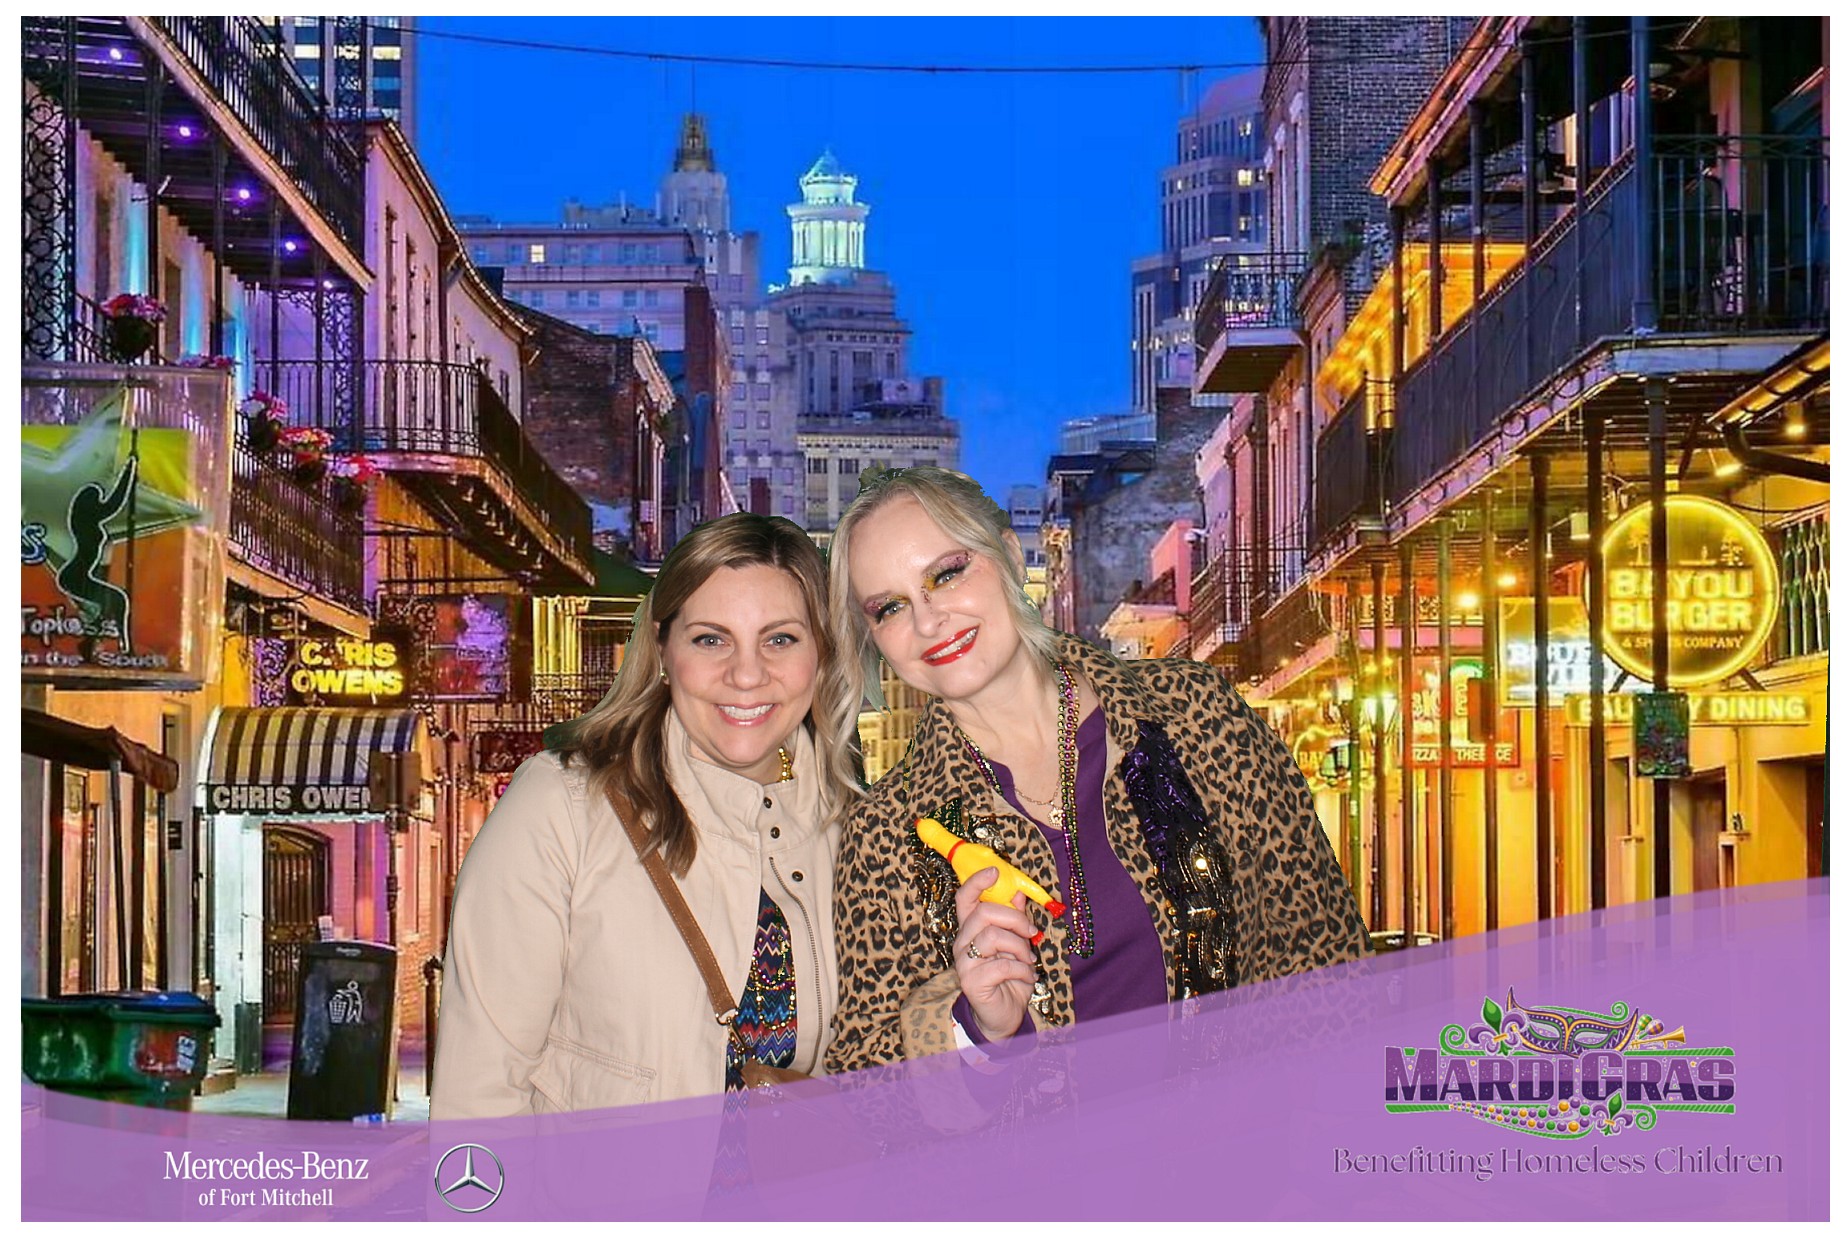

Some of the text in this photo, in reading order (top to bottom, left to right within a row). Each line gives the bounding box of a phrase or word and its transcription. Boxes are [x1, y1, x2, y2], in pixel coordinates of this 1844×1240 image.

[1684, 634, 1744, 648] COMPANY
[291, 668, 404, 695] OWENS
[1710, 696, 1806, 722] DINING
[212, 785, 371, 811] CHRIS OWEN
